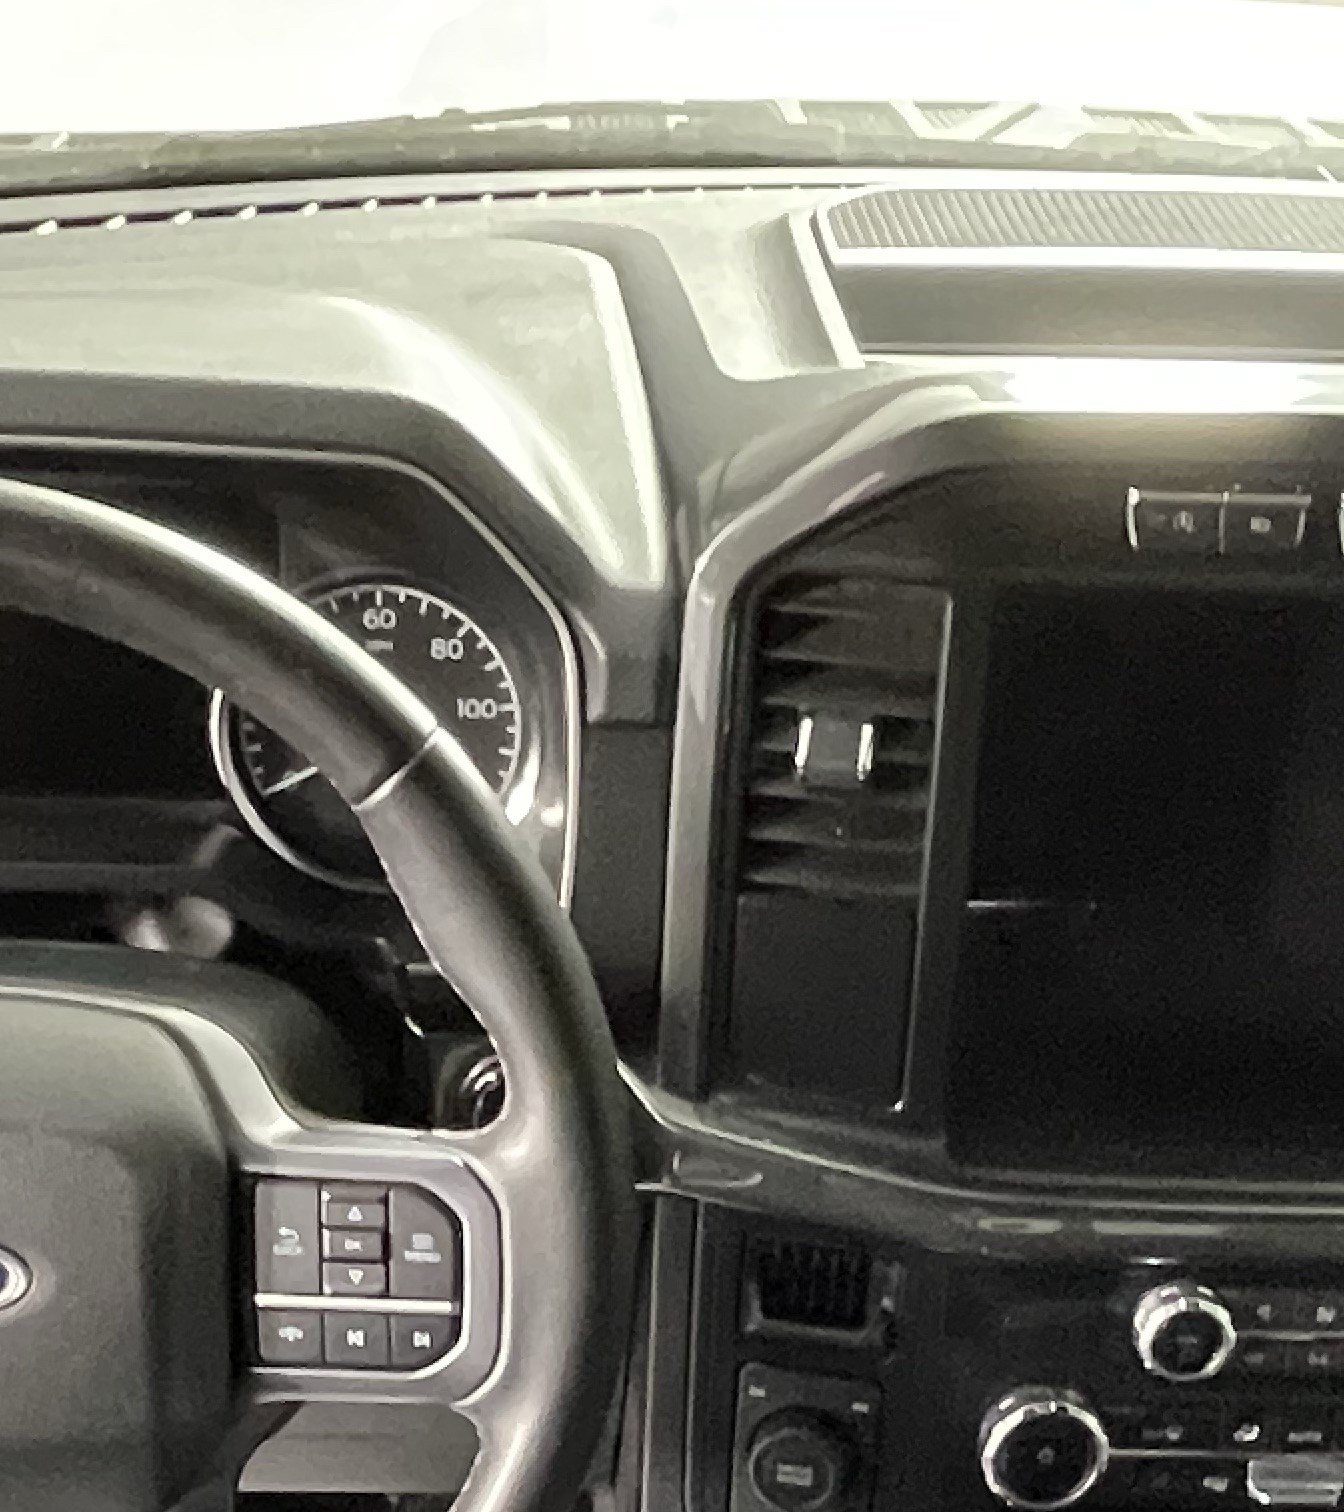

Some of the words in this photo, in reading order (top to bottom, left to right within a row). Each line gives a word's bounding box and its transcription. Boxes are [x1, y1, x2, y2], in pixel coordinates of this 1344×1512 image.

[363, 608, 396, 629] 60
[430, 638, 464, 660] 80
[457, 698, 498, 719] 100
